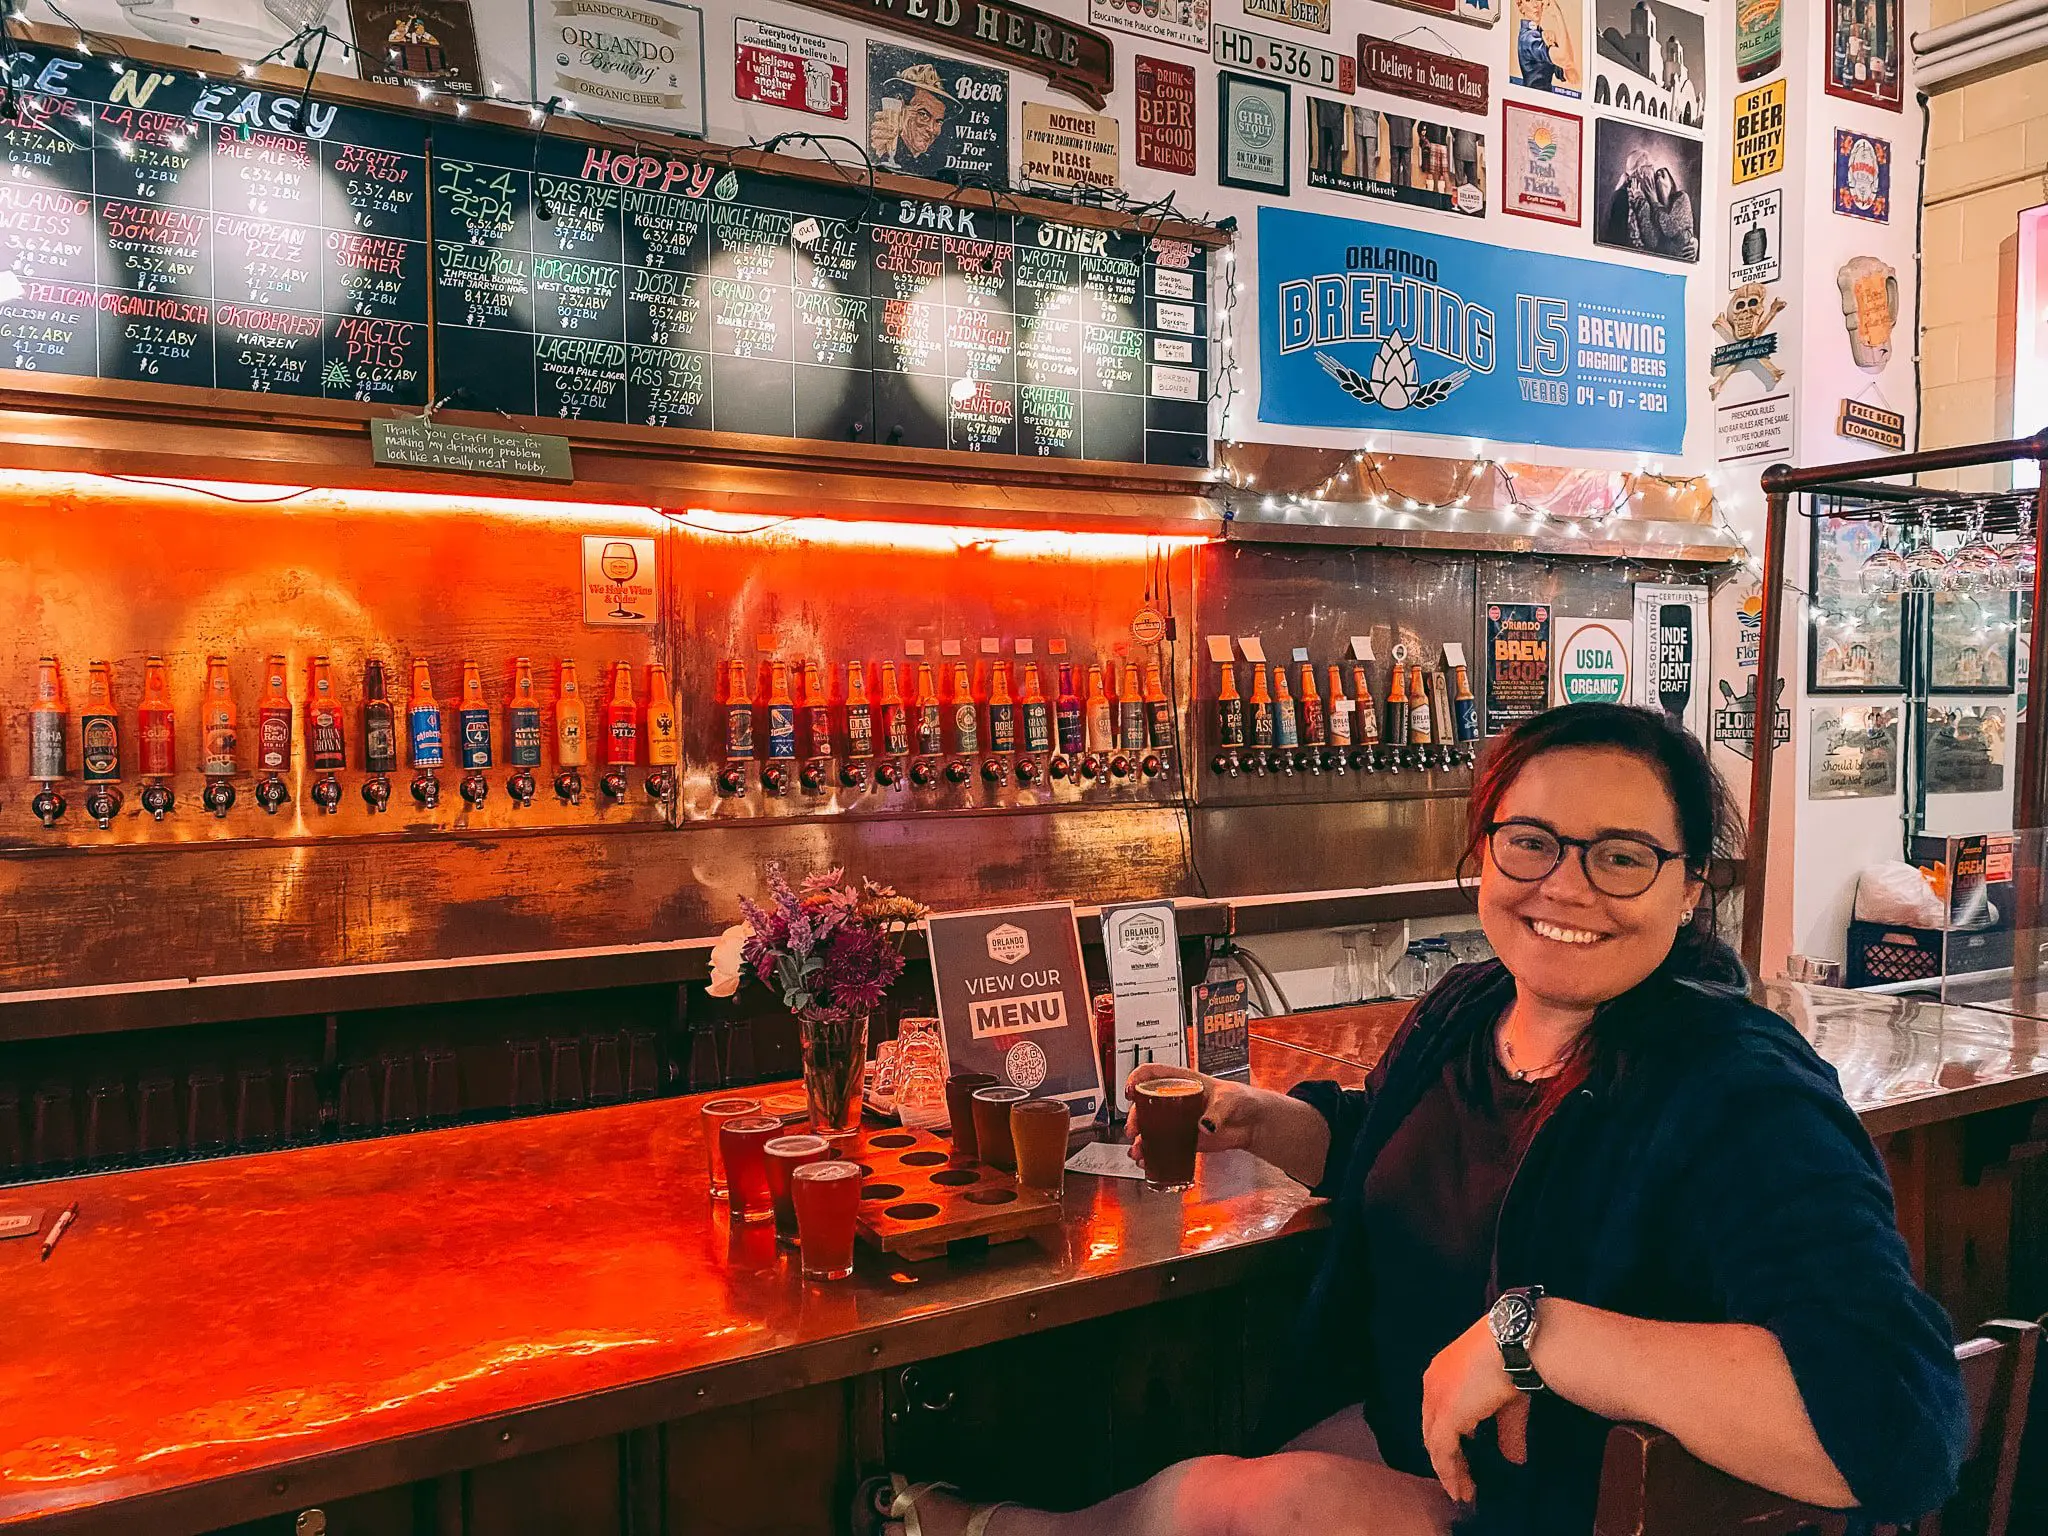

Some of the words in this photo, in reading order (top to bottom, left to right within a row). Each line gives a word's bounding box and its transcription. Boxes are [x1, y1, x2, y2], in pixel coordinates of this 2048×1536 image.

[577, 2, 658, 26] HANDCRAFTED
[1289, 2, 1328, 31] BEER!
[562, 26, 674, 63] ORLANDO
[759, 28, 800, 44] Everybody
[803, 37, 826, 48] needs
[976, 4, 1080, 67] HERE
[1739, 37, 1761, 51] PALE
[1763, 27, 1780, 40] ALE
[743, 35, 786, 52] something
[789, 43, 797, 52] to
[799, 46, 828, 60] believe
[830, 53, 840, 63] in.
[752, 51, 757, 61] I
[758, 52, 794, 70] believe
[579, 48, 659, 83] Brewing
[746, 61, 751, 71] I
[753, 64, 771, 76] will
[773, 67, 796, 81] have
[1157, 68, 1184, 85] DRINK
[1320, 59, 1334, 83] D
[1372, 49, 1377, 70] I
[1380, 52, 1414, 81] believe
[1416, 63, 1426, 83] in
[1429, 66, 1454, 91] Santa
[1457, 73, 1482, 99] Claus
[109, 69, 175, 108] N'
[580, 82, 630, 101] ORGANIC
[632, 91, 660, 105] BEER
[754, 76, 792, 91] another
[760, 86, 786, 100] beer!
[955, 77, 1003, 102] BEER
[1156, 84, 1193, 104] GOOD
[192, 84, 338, 138] EASY
[1139, 95, 1192, 128] BEER
[1747, 95, 1760, 111] IS
[1762, 90, 1773, 107] IT
[969, 110, 990, 125] It's
[1049, 113, 1096, 134] NOTICE!
[1238, 110, 1271, 127] GIRL
[1737, 103, 1783, 140] BEER
[955, 125, 997, 141] What's
[1026, 130, 1033, 141] IF
[1033, 131, 1054, 145] YOU'RE
[1055, 134, 1081, 150] DRINKING
[1083, 139, 1091, 152] TO
[1156, 128, 1192, 150] GOOD
[1238, 122, 1271, 138] STOUT
[961, 142, 985, 157] For
[1140, 133, 1195, 168] FRIENDS
[1736, 128, 1782, 158] THIRTY
[342, 145, 401, 166] RIGHT
[944, 155, 992, 171] Dinner
[1052, 150, 1091, 168] PLEASE
[1741, 149, 1777, 176] YET?
[335, 159, 360, 174] ON
[366, 163, 408, 183] RED!
[581, 147, 714, 198] HOPPY
[1029, 160, 1051, 177] PAY
[1053, 165, 1065, 178] IN
[1066, 167, 1114, 187] ADVANCE
[103, 201, 210, 233] EMINENT
[446, 194, 515, 225] IPA
[623, 190, 708, 222] ENTITLEMENT
[1733, 209, 1760, 225] TAP
[1762, 204, 1777, 217] IT
[1740, 204, 1750, 214] IF
[1752, 198, 1771, 211] YOU
[710, 203, 749, 228] UNCLE
[753, 211, 791, 234] MATT'S
[899, 200, 977, 239] DARK
[108, 221, 201, 247] DOMAIN
[327, 231, 408, 260] STEAMEE
[716, 225, 787, 246] GRAPEFRUIT
[1037, 221, 1108, 258] OTHER
[108, 239, 172, 256] SCOTTISH
[175, 248, 199, 259] ALE
[1156, 253, 1190, 268] AGED
[336, 251, 406, 279] SUMMER
[534, 258, 620, 289] HOPGASMIC
[1345, 246, 1438, 283] ORLANDO
[1731, 266, 1754, 279] THEY
[1755, 260, 1778, 273] WILL
[1742, 270, 1767, 283] COME
[635, 269, 697, 299] DOBLE
[99, 293, 209, 324] ORGANIKÖLSCH
[216, 304, 324, 338] OKTOBERFEST
[335, 318, 414, 346] MAGIC
[1279, 272, 1496, 375] BREWING
[236, 332, 298, 349] MÄRZEN
[1084, 325, 1143, 347] PEDALER'S
[1516, 293, 1569, 377] 15
[1578, 314, 1666, 355] BREWING
[346, 341, 404, 368] PILS
[536, 335, 625, 368] LAGERHEAD
[630, 346, 703, 372] POMPOUS
[1082, 341, 1109, 356] HARD
[1110, 345, 1142, 361] CIDER
[1578, 349, 1628, 373] ORGANIC
[1631, 356, 1667, 377] BEERS
[630, 366, 662, 388] ASS
[668, 371, 703, 390] IPA
[1518, 376, 1569, 406] YEARS
[1731, 407, 1758, 421] PRESCHOOL
[1759, 404, 1775, 416] RULES
[1850, 405, 1874, 422] FREE
[1876, 411, 1899, 428] BEER
[383, 423, 420, 435] Thank
[424, 428, 446, 440] you
[452, 431, 488, 443] craft
[493, 435, 520, 446] beer
[525, 438, 541, 448] for
[1847, 423, 1900, 446] TOMORROW
[385, 436, 425, 451] making
[429, 440, 443, 452] my
[447, 439, 494, 458] drinking
[500, 448, 541, 461] problem
[386, 448, 407, 460] look
[410, 450, 427, 462] like
[433, 454, 440, 463] a
[443, 454, 474, 470] really
[478, 459, 508, 469] neat
[515, 459, 548, 475] hobby.
[1659, 592, 1693, 601] CERTIFIED
[1502, 619, 1540, 631] ORLANDO
[1660, 627, 1688, 645] INDE
[1495, 640, 1547, 661] BREW
[1576, 649, 1614, 669] USDA
[1661, 645, 1684, 662] PEN
[1660, 662, 1691, 681] DENT
[1570, 678, 1618, 695] ORGANIC
[1660, 680, 1688, 693] CRAFT
[1957, 860, 1985, 875] BREW
[992, 936, 1024, 947] ORLANDO
[1124, 926, 1159, 937] ORLANDO
[965, 975, 1014, 995] VIEW
[1020, 969, 1060, 988] OUR
[976, 998, 1060, 1031] MENU
[1203, 1010, 1247, 1034] BREW
